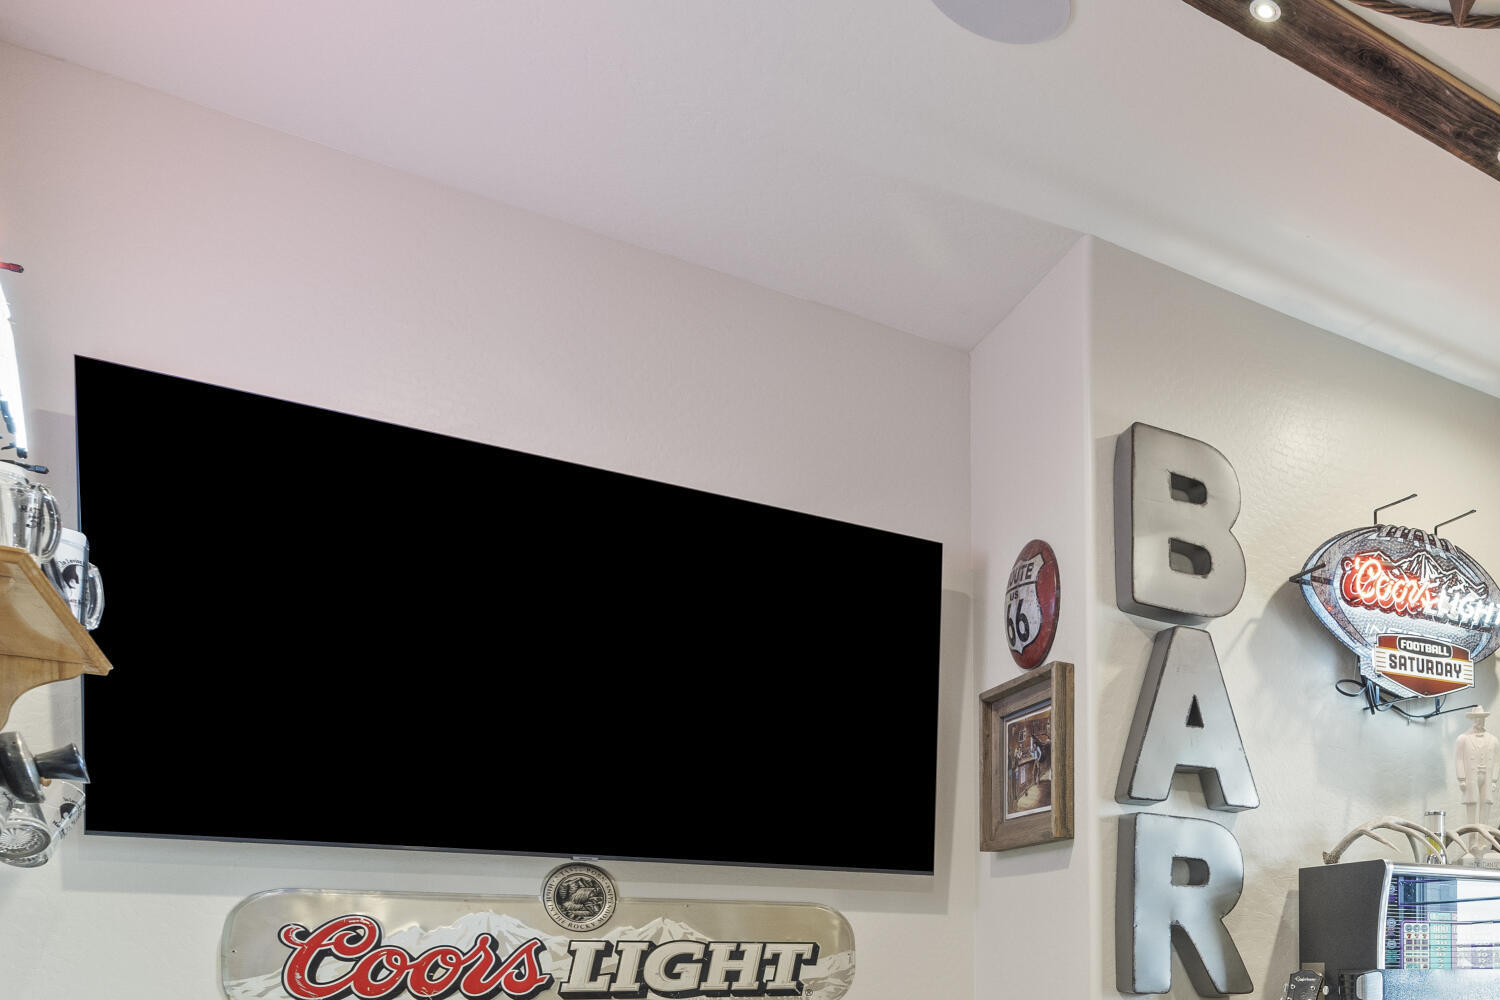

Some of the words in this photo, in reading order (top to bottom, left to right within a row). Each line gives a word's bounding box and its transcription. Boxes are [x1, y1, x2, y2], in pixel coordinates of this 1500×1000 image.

[1009, 591, 1019, 601] US
[1007, 598, 1030, 647] 66
[1400, 638, 1450, 657] FOOTBALL
[1388, 653, 1462, 679] SATURDAY
[558, 939, 822, 1000] LIGHT
